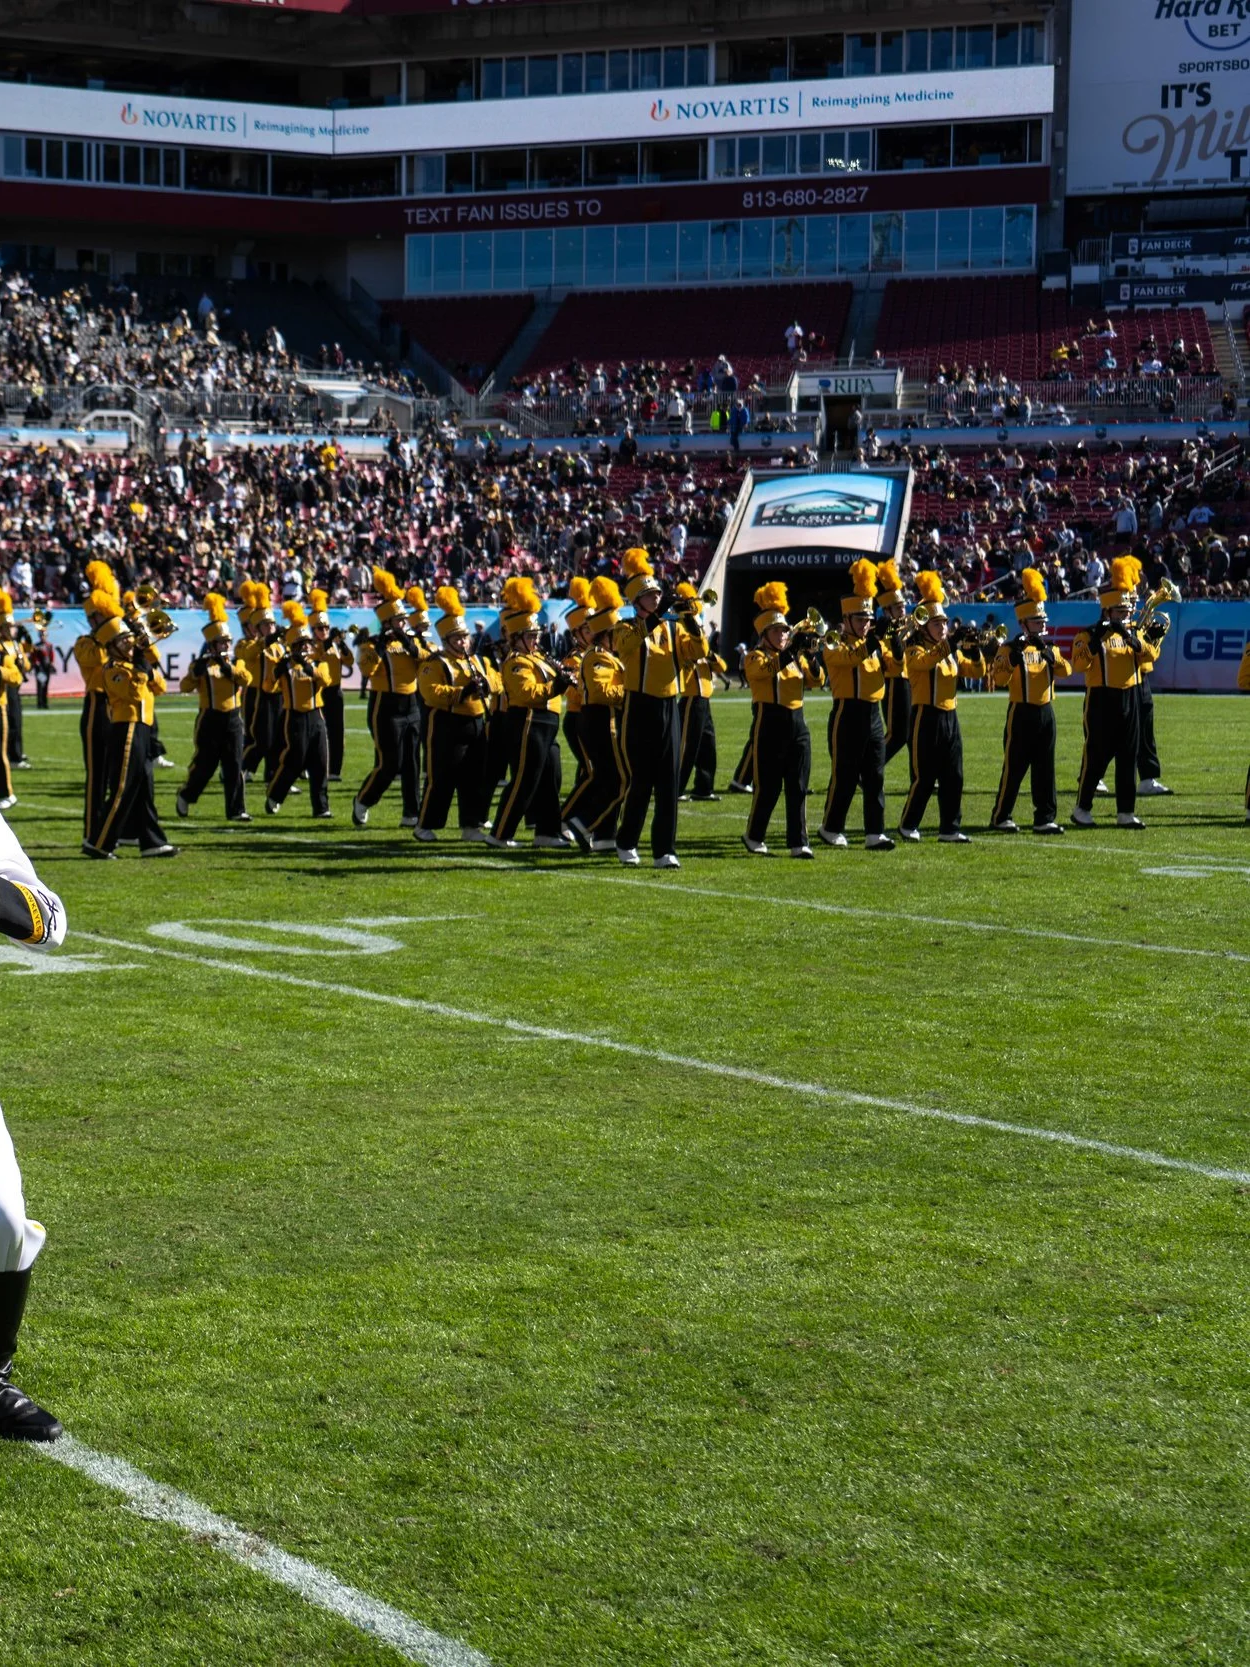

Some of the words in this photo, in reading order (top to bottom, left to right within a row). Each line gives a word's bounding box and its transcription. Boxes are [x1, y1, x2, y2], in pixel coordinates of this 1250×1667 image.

[1208, 23, 1241, 38] BET
[677, 96, 790, 119] NOVARTIS
[812, 93, 890, 109] Reimagining
[894, 88, 954, 103] Medicine
[1161, 82, 1212, 109] IT'S
[143, 109, 237, 133] NOVARTIS
[253, 119, 315, 137] Reimagining
[318, 125, 369, 137] Medicine
[742, 186, 869, 208] 813-680-2827
[404, 207, 452, 224] TEXT
[456, 205, 494, 222] FAN
[500, 201, 570, 220] ISSUES
[575, 199, 602, 217] TO
[1141, 240, 1162, 251] FAN
[1164, 238, 1192, 250] DECK
[1133, 286, 1154, 297] FAN
[1156, 284, 1186, 296] DECK
[834, 378, 875, 393] RIPA
[751, 553, 828, 566] RELIAQUEST
